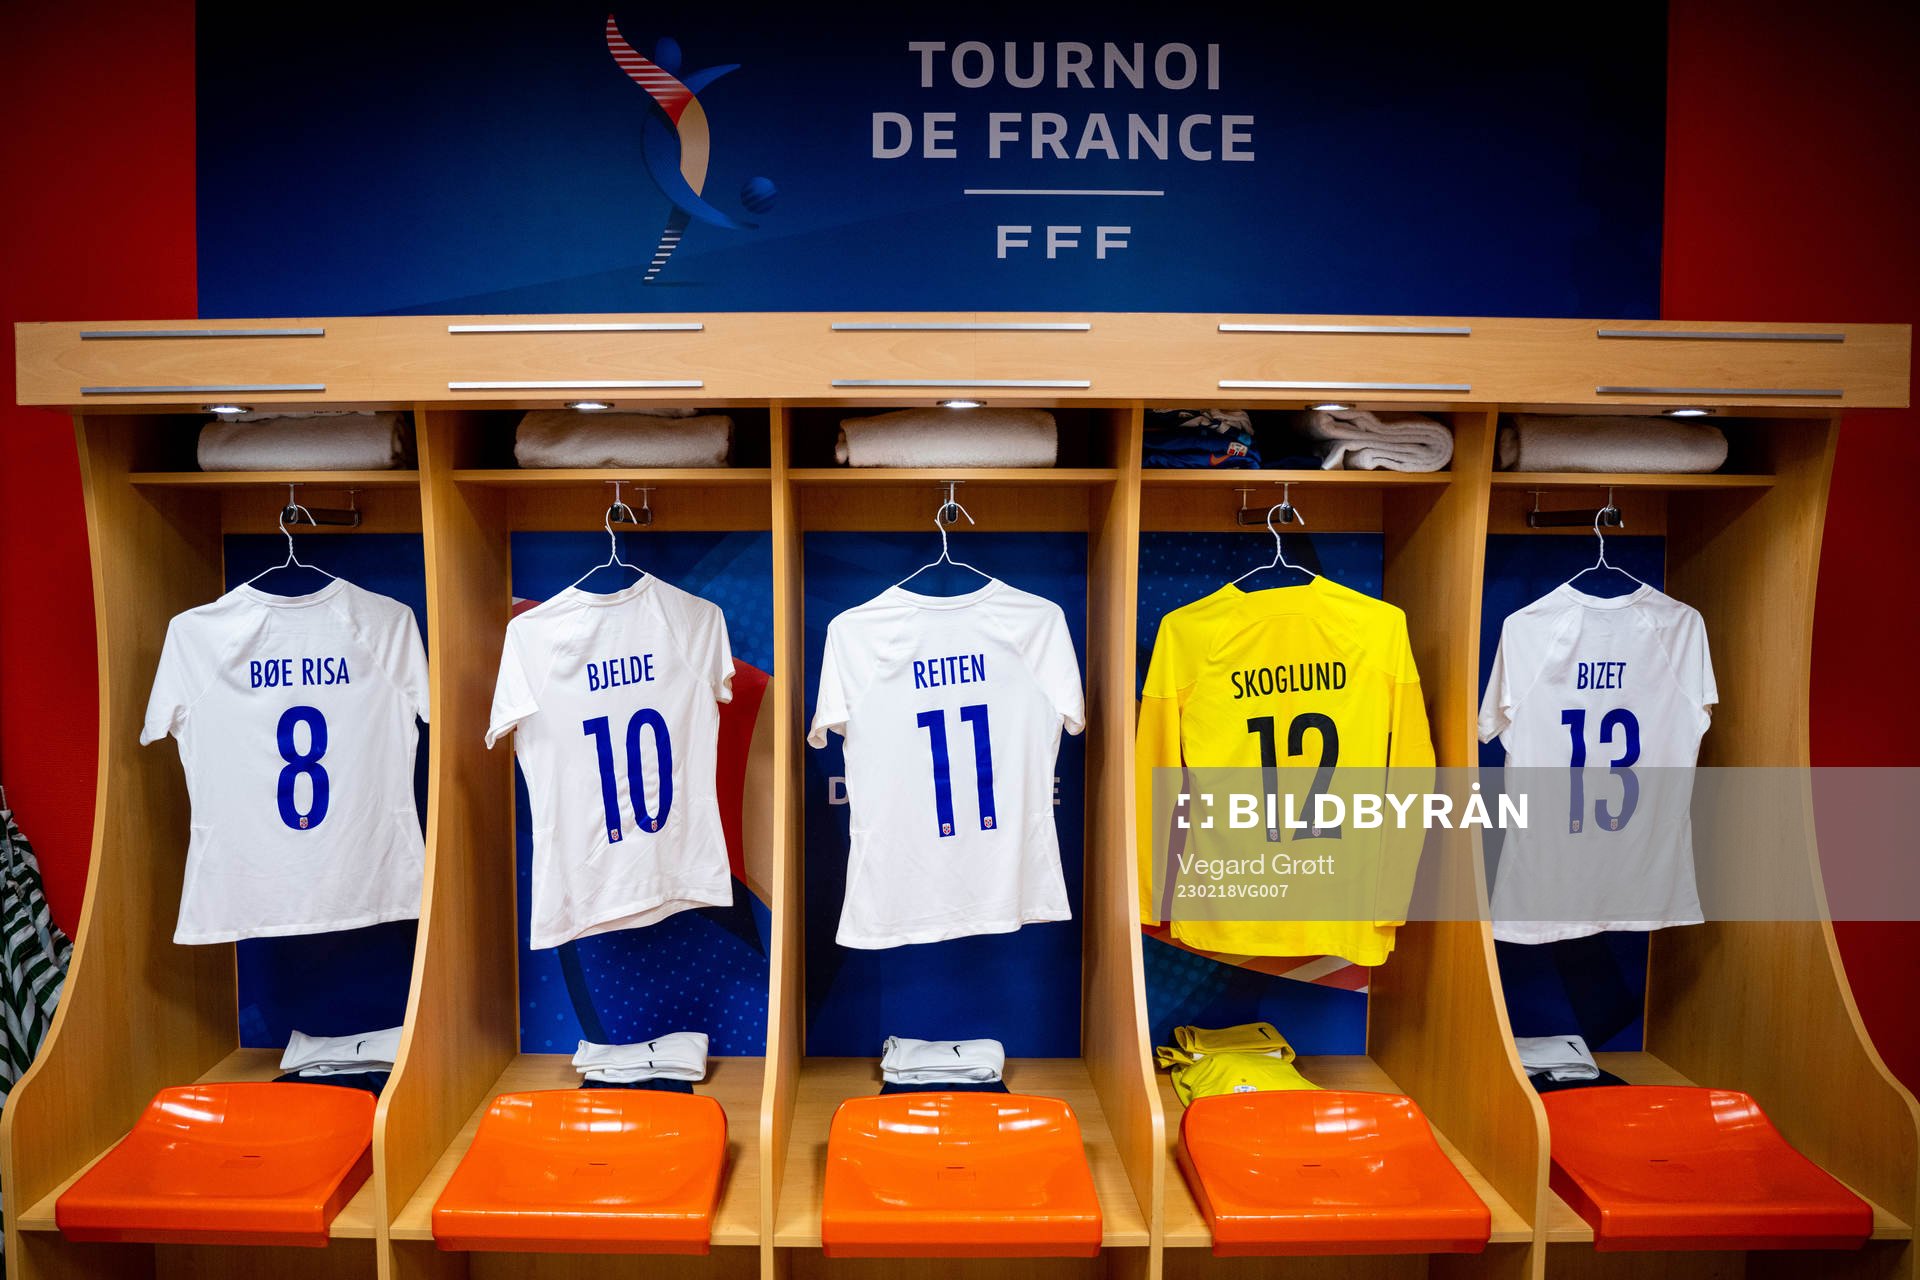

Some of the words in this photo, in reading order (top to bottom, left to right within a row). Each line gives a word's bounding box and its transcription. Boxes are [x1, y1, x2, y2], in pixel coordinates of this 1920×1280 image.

[908, 41, 1219, 90] TOURNOI
[872, 112, 957, 159] DE
[989, 112, 1255, 162] FRANCE
[997, 225, 1131, 260] FFF
[249, 658, 293, 689] BØE
[301, 656, 350, 686] RISA
[586, 653, 655, 692] BJELDE
[912, 653, 986, 689] REITEN
[1231, 660, 1347, 700] SKOGLUND
[1576, 661, 1627, 690] BIZET
[276, 705, 331, 831] 8
[582, 707, 674, 845] 10
[916, 703, 998, 838] 11
[1246, 712, 1343, 843] 12
[1560, 707, 1641, 835] 13
